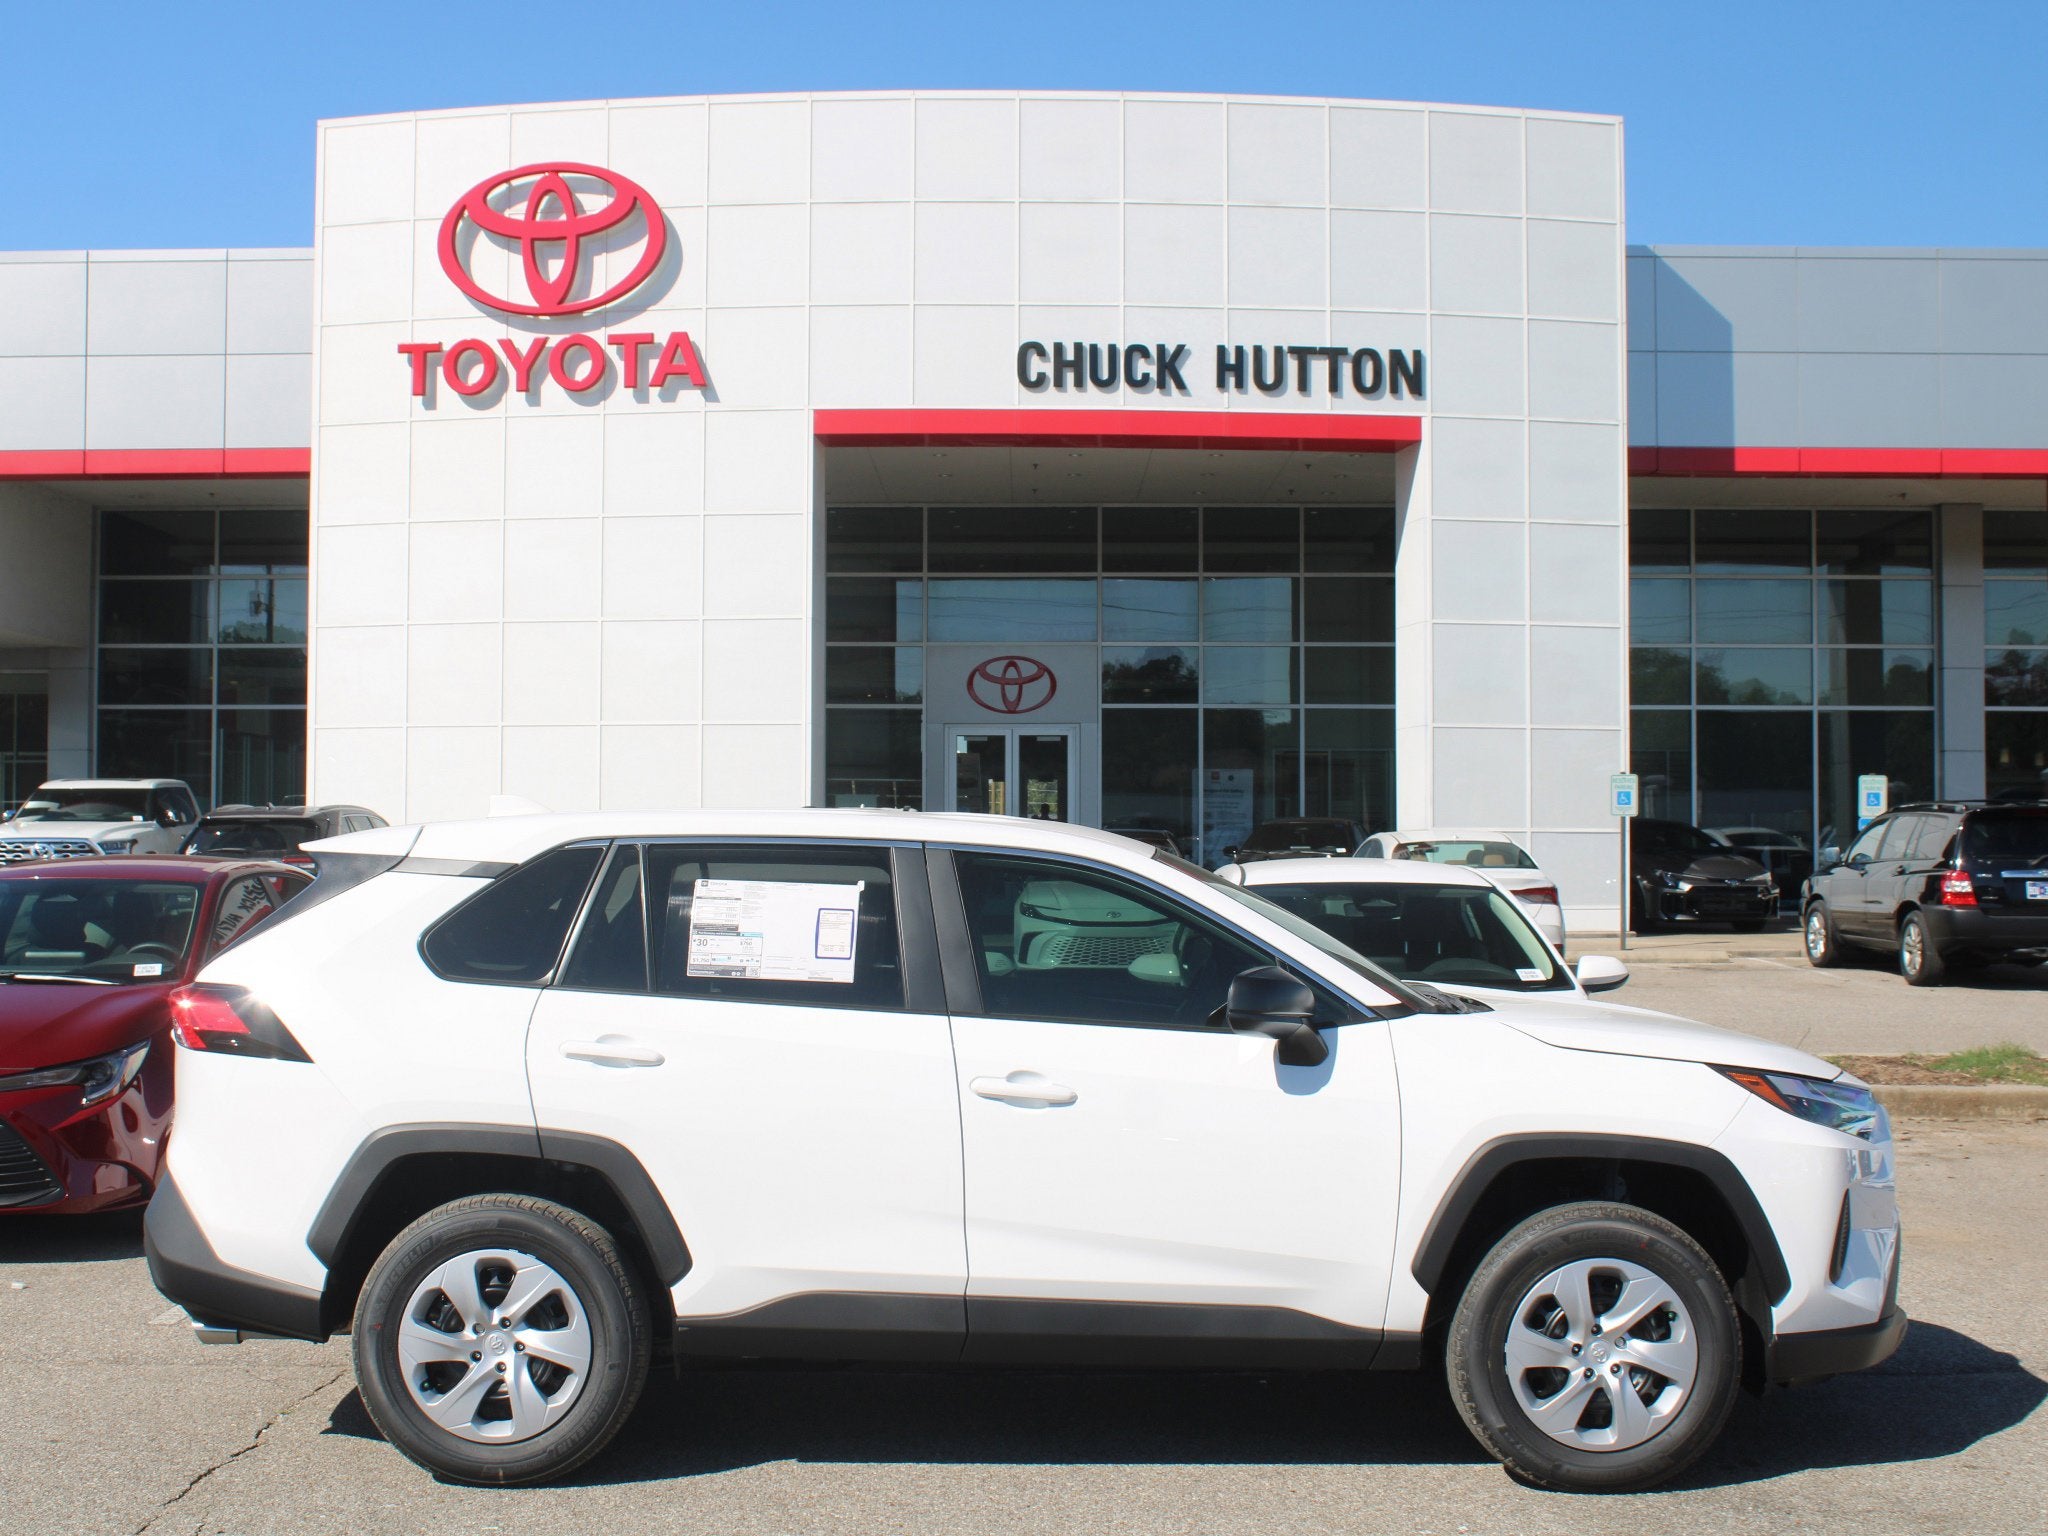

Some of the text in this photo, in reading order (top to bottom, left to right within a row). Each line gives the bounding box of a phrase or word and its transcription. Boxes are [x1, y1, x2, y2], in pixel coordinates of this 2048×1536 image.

[397, 331, 707, 397] TOYOTA
[1017, 341, 1423, 397] CHUCK HUTTON
[696, 938, 708, 947] 30
